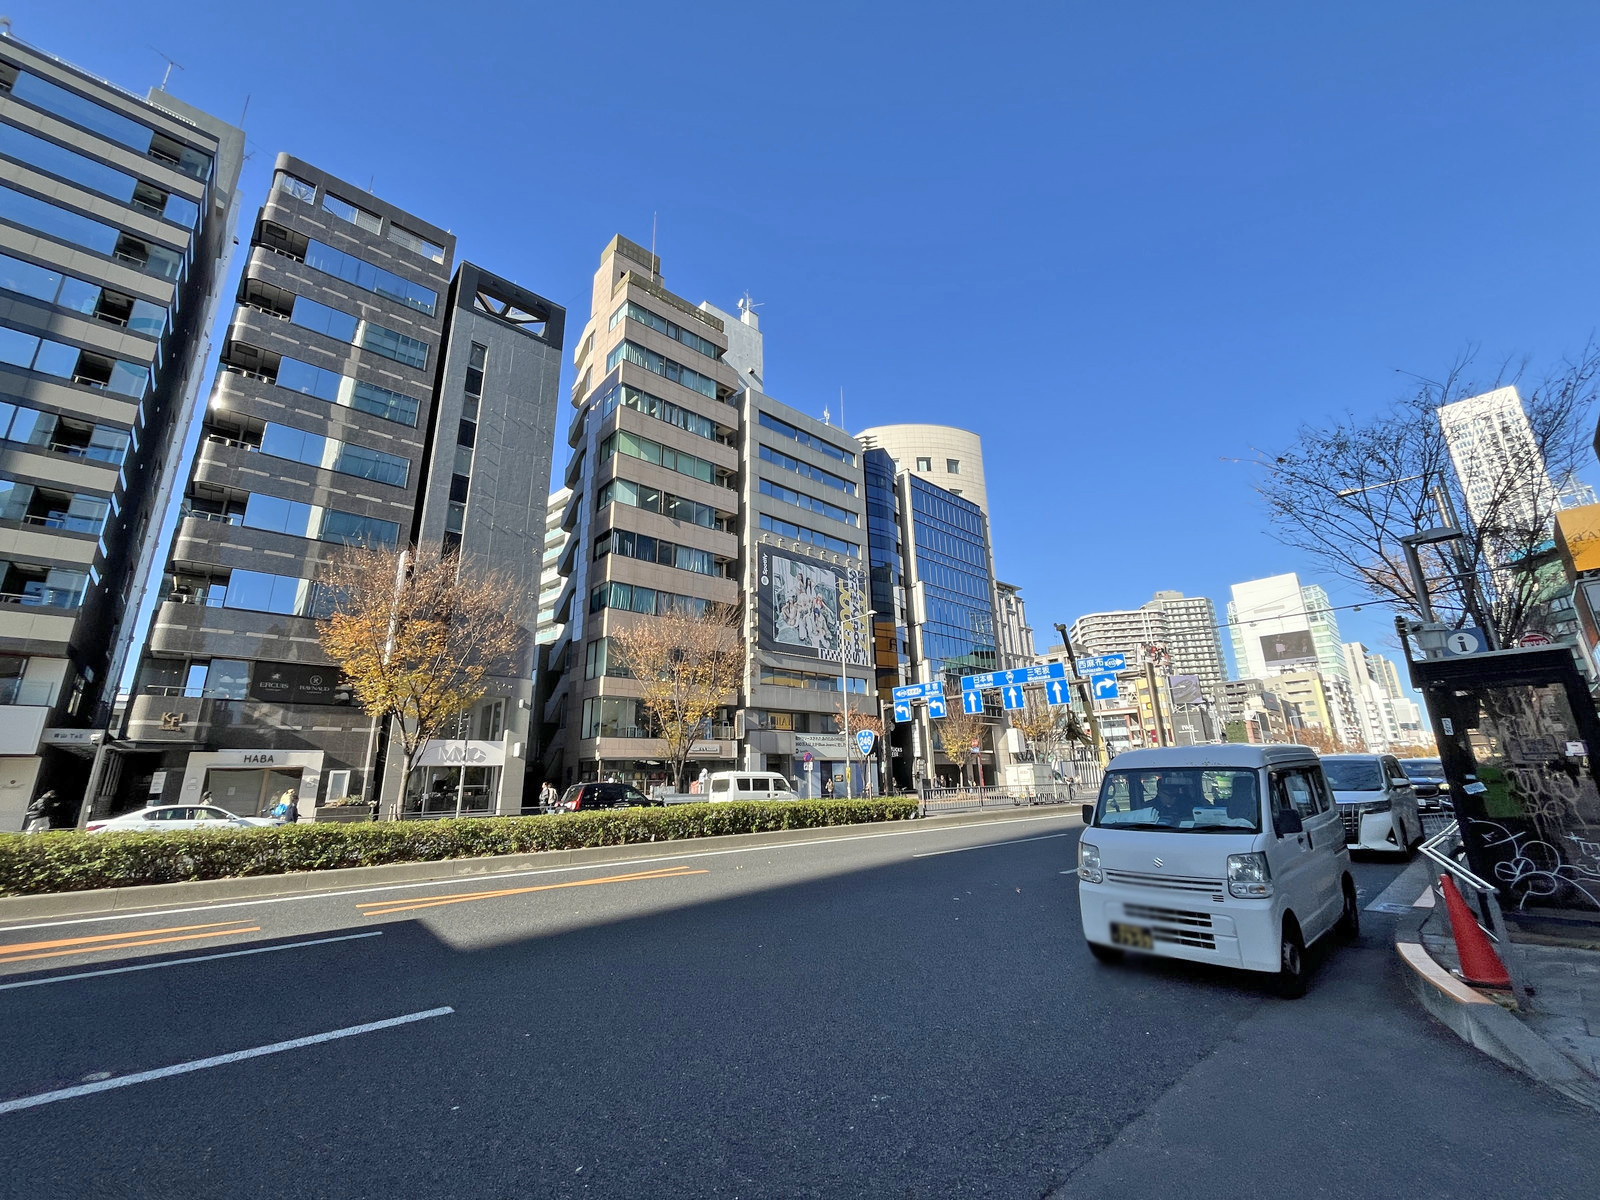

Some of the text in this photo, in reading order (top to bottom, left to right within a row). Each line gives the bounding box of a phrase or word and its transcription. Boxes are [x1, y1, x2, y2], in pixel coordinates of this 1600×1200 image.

[1078, 657, 1103, 669] 西麻布
[1026, 666, 1050, 676] 三宅坂
[860, 736, 872, 746] 246
[243, 754, 274, 763] HABA
